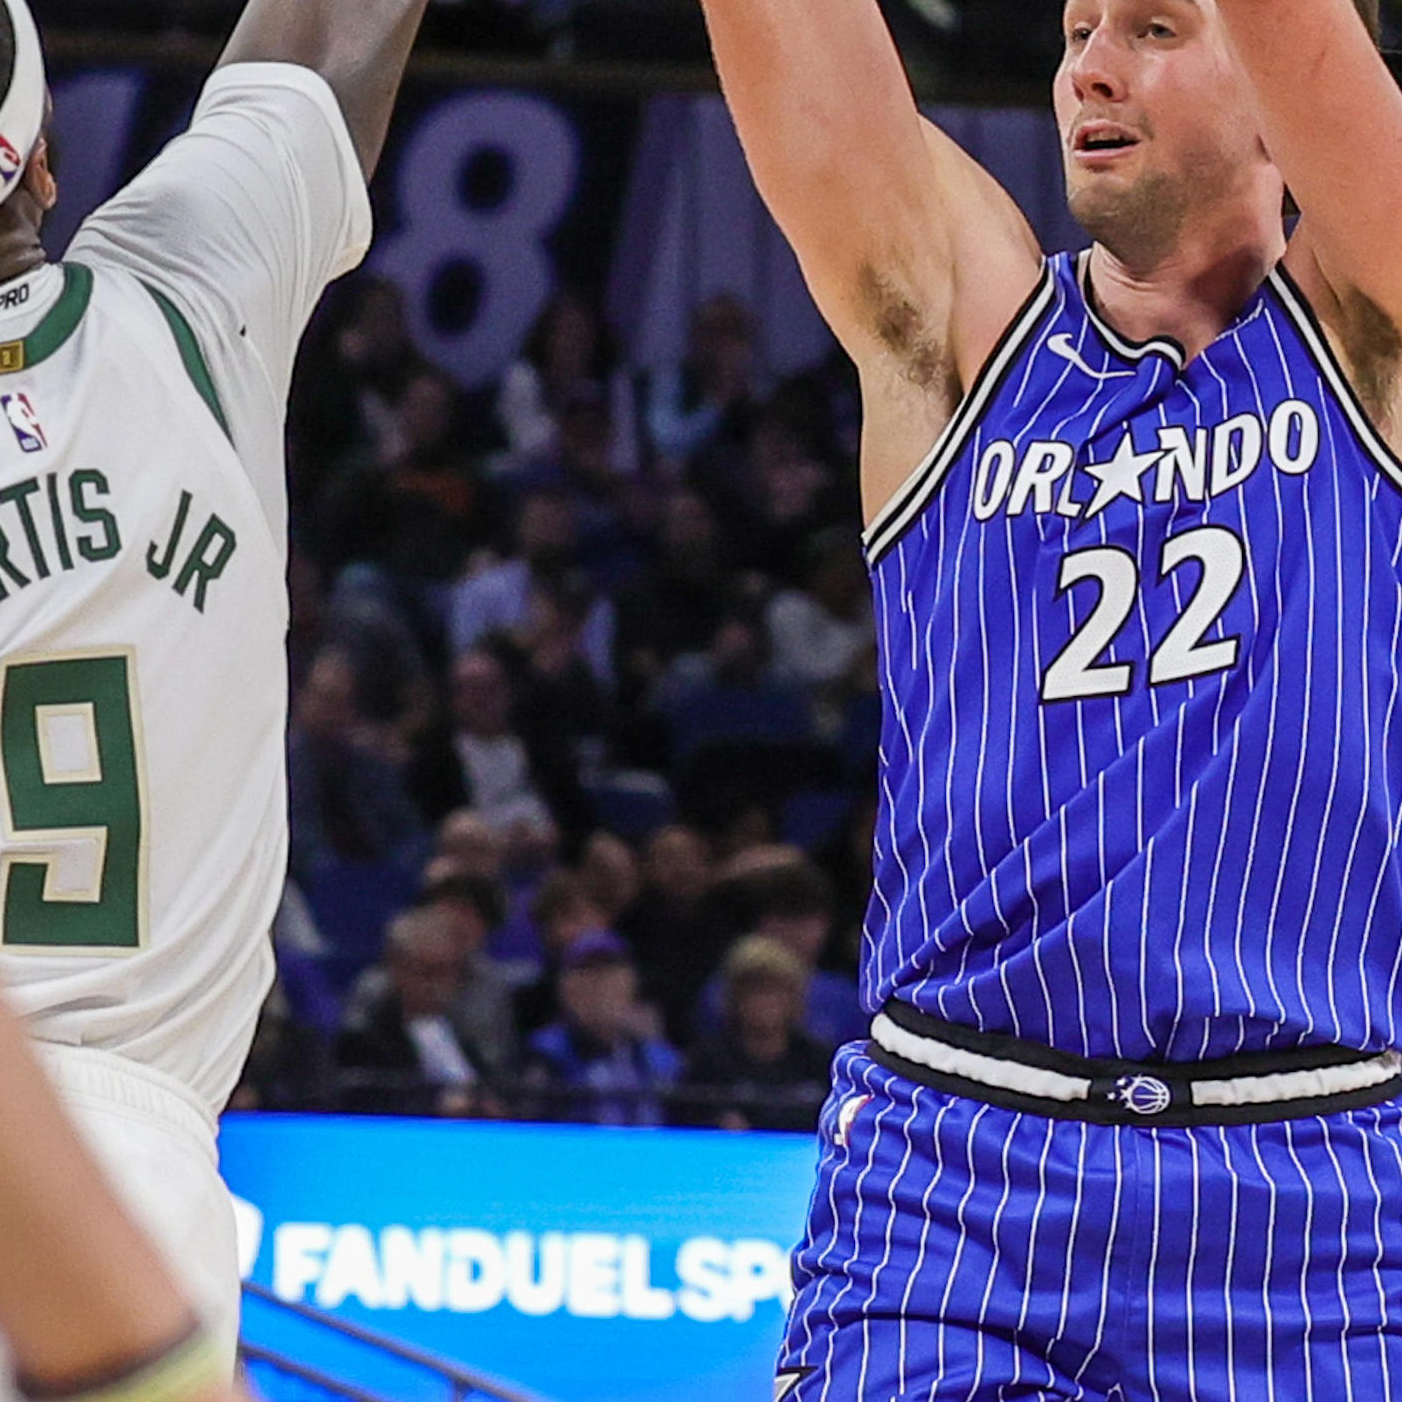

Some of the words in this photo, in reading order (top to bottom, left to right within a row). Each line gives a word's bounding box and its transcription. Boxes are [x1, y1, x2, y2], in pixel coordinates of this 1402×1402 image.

[144, 489, 238, 615] JR
[1039, 524, 1247, 702] 22
[273, 1221, 676, 1320] FANDUEL
[675, 1234, 797, 1324] SP
